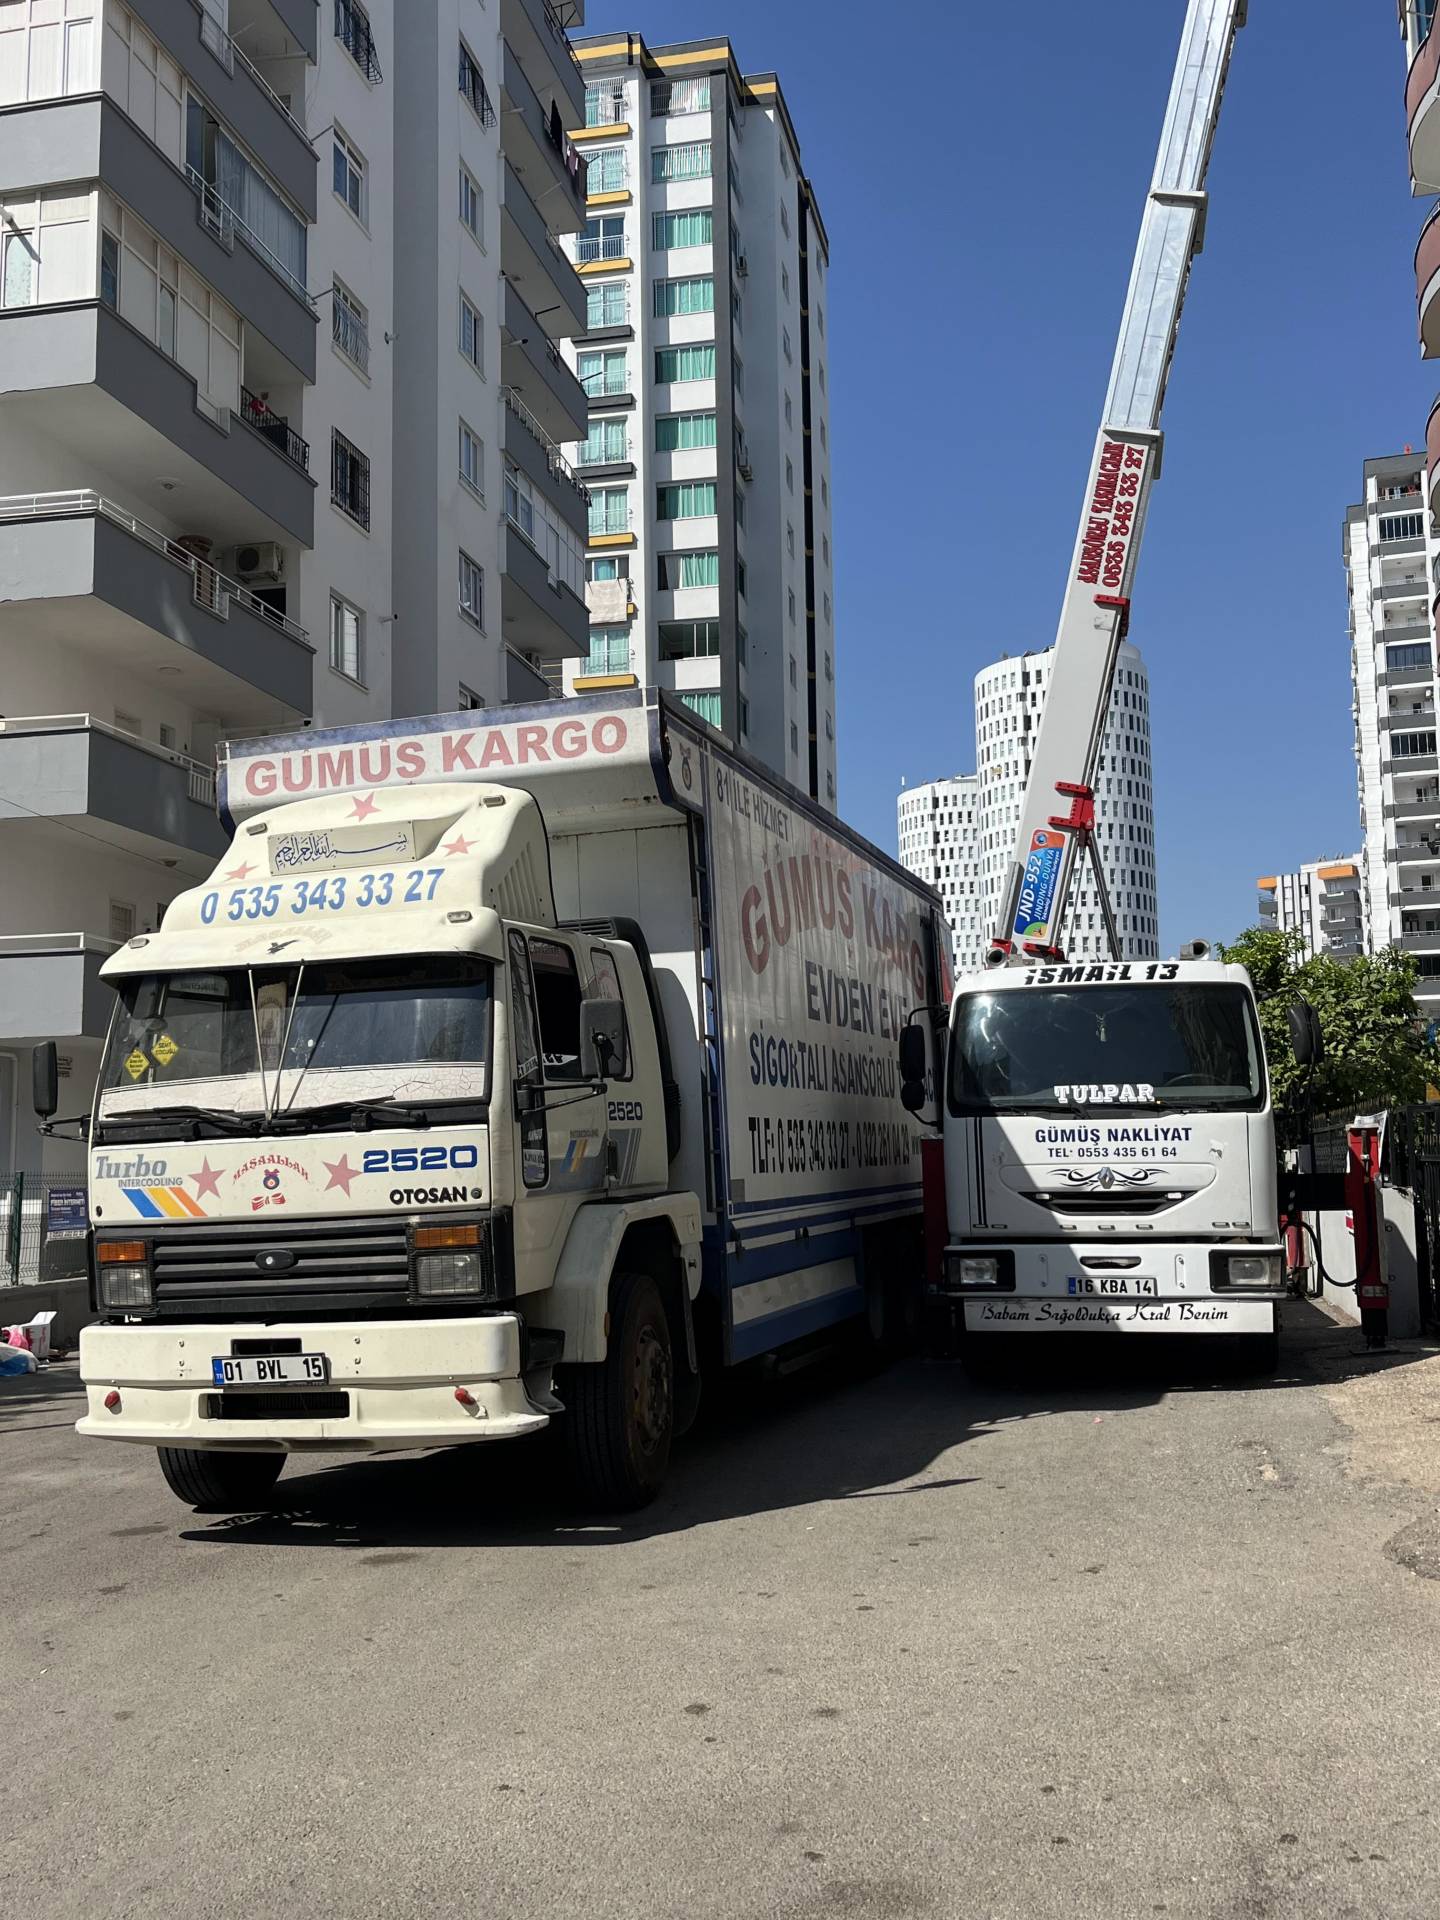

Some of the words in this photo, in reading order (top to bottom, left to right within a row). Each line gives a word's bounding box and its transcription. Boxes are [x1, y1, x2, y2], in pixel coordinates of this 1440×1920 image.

[1124, 445, 1144, 470] 27
[1118, 472, 1139, 497] 33
[1111, 500, 1134, 537] 343
[1102, 540, 1126, 588] 0535
[441, 715, 628, 772] KARGO
[716, 768, 730, 806] 81
[200, 892, 219, 924] 0
[227, 884, 284, 921] 535
[290, 877, 347, 914] 343
[355, 872, 395, 907] 33
[403, 868, 446, 903] 27
[1019, 855, 1042, 922] JND-952
[862, 880, 924, 1002] KARG
[1146, 963, 1180, 981] 13
[805, 959, 874, 1036] EVDEN
[878, 987, 908, 1044] EVE
[750, 1019, 828, 1092] SİGORTALI
[831, 1046, 896, 1099] ASANSÖRLÜ
[1053, 1083, 1155, 1104] TULPAR
[607, 1101, 643, 1121] 2520
[748, 1116, 776, 1174] TLF:
[777, 1118, 785, 1174] 0
[787, 1119, 806, 1173] 535
[807, 1119, 826, 1172] 343
[826, 1119, 839, 1171] 33
[839, 1121, 850, 1169] 27
[856, 1121, 862, 1169] 0
[863, 1121, 878, 1167] 322
[1035, 1125, 1100, 1146] GÜMÜŞ
[1107, 1124, 1192, 1142] NAKLİYAT
[363, 1145, 478, 1173] 2520
[1077, 1147, 1109, 1158] 0553
[1113, 1147, 1137, 1157] 435
[1141, 1147, 1156, 1157] 61
[1161, 1147, 1177, 1157] 64
[96, 1153, 167, 1179] Turbo
[118, 1177, 184, 1188] INTERCOOLING
[389, 1186, 468, 1205] OTOSAN
[1077, 1279, 1094, 1293] 16
[1100, 1279, 1128, 1293] KBA
[1135, 1280, 1152, 1294] 14
[980, 1303, 1029, 1321] Babam
[1126, 1303, 1171, 1321] Kral
[1179, 1303, 1229, 1321] Benim
[223, 1361, 243, 1381] 01
[256, 1359, 288, 1380] BVL
[302, 1357, 323, 1378] 15
